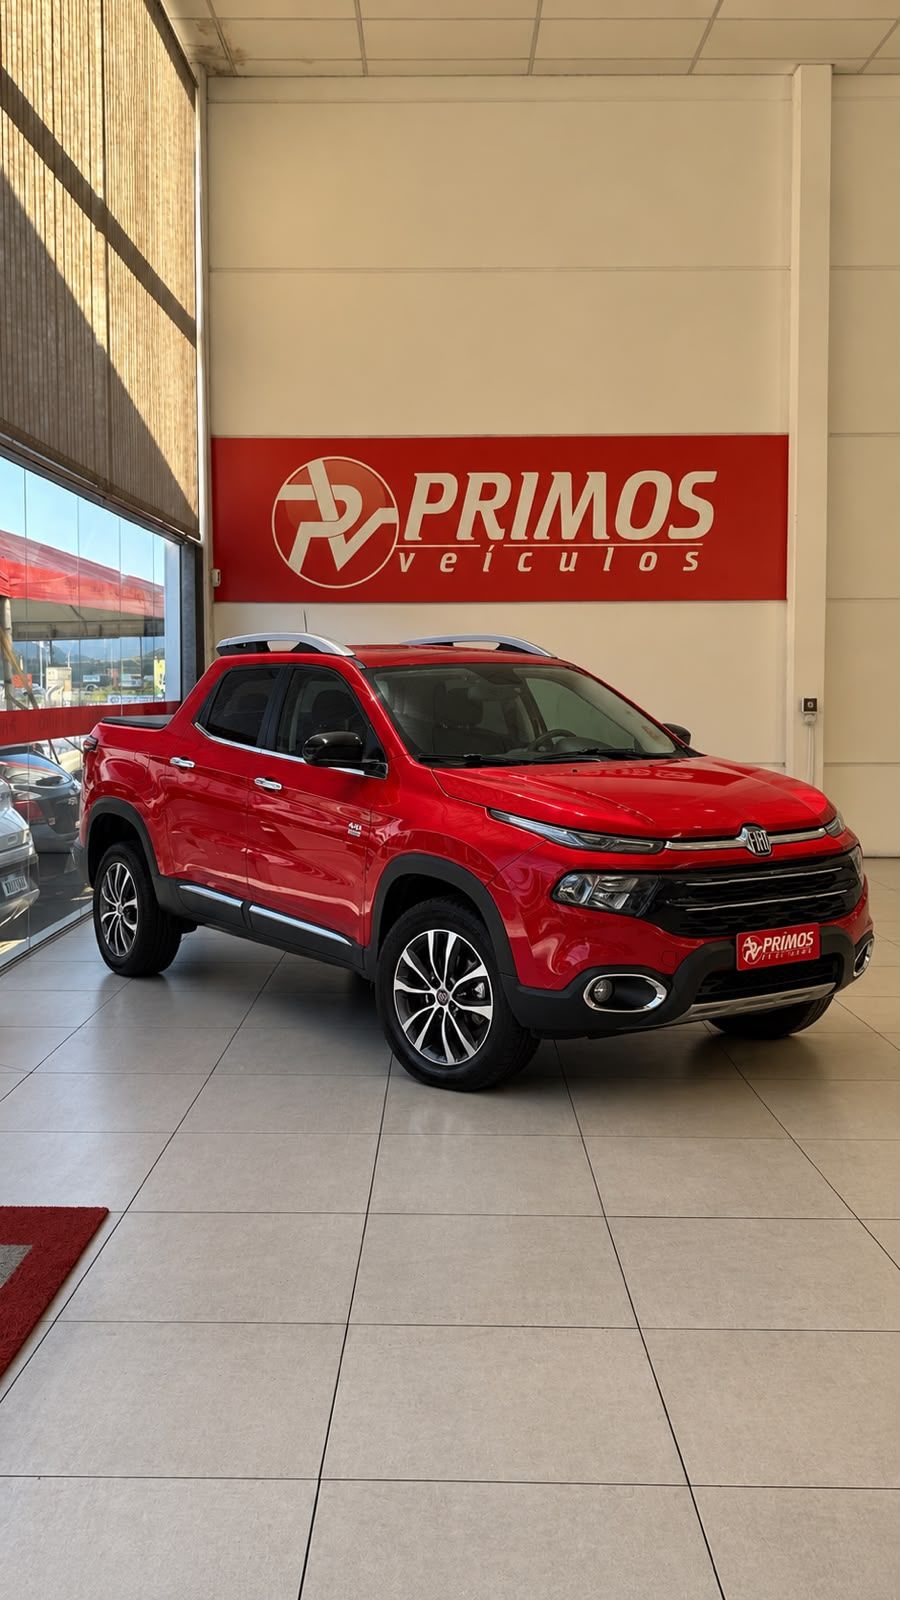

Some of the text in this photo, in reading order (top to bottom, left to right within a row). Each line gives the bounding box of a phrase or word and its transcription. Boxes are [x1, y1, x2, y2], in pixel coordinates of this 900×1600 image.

[404, 470, 717, 541] PRIMOS
[399, 545, 699, 573] veículos
[762, 931, 814, 953] PRIMOS
